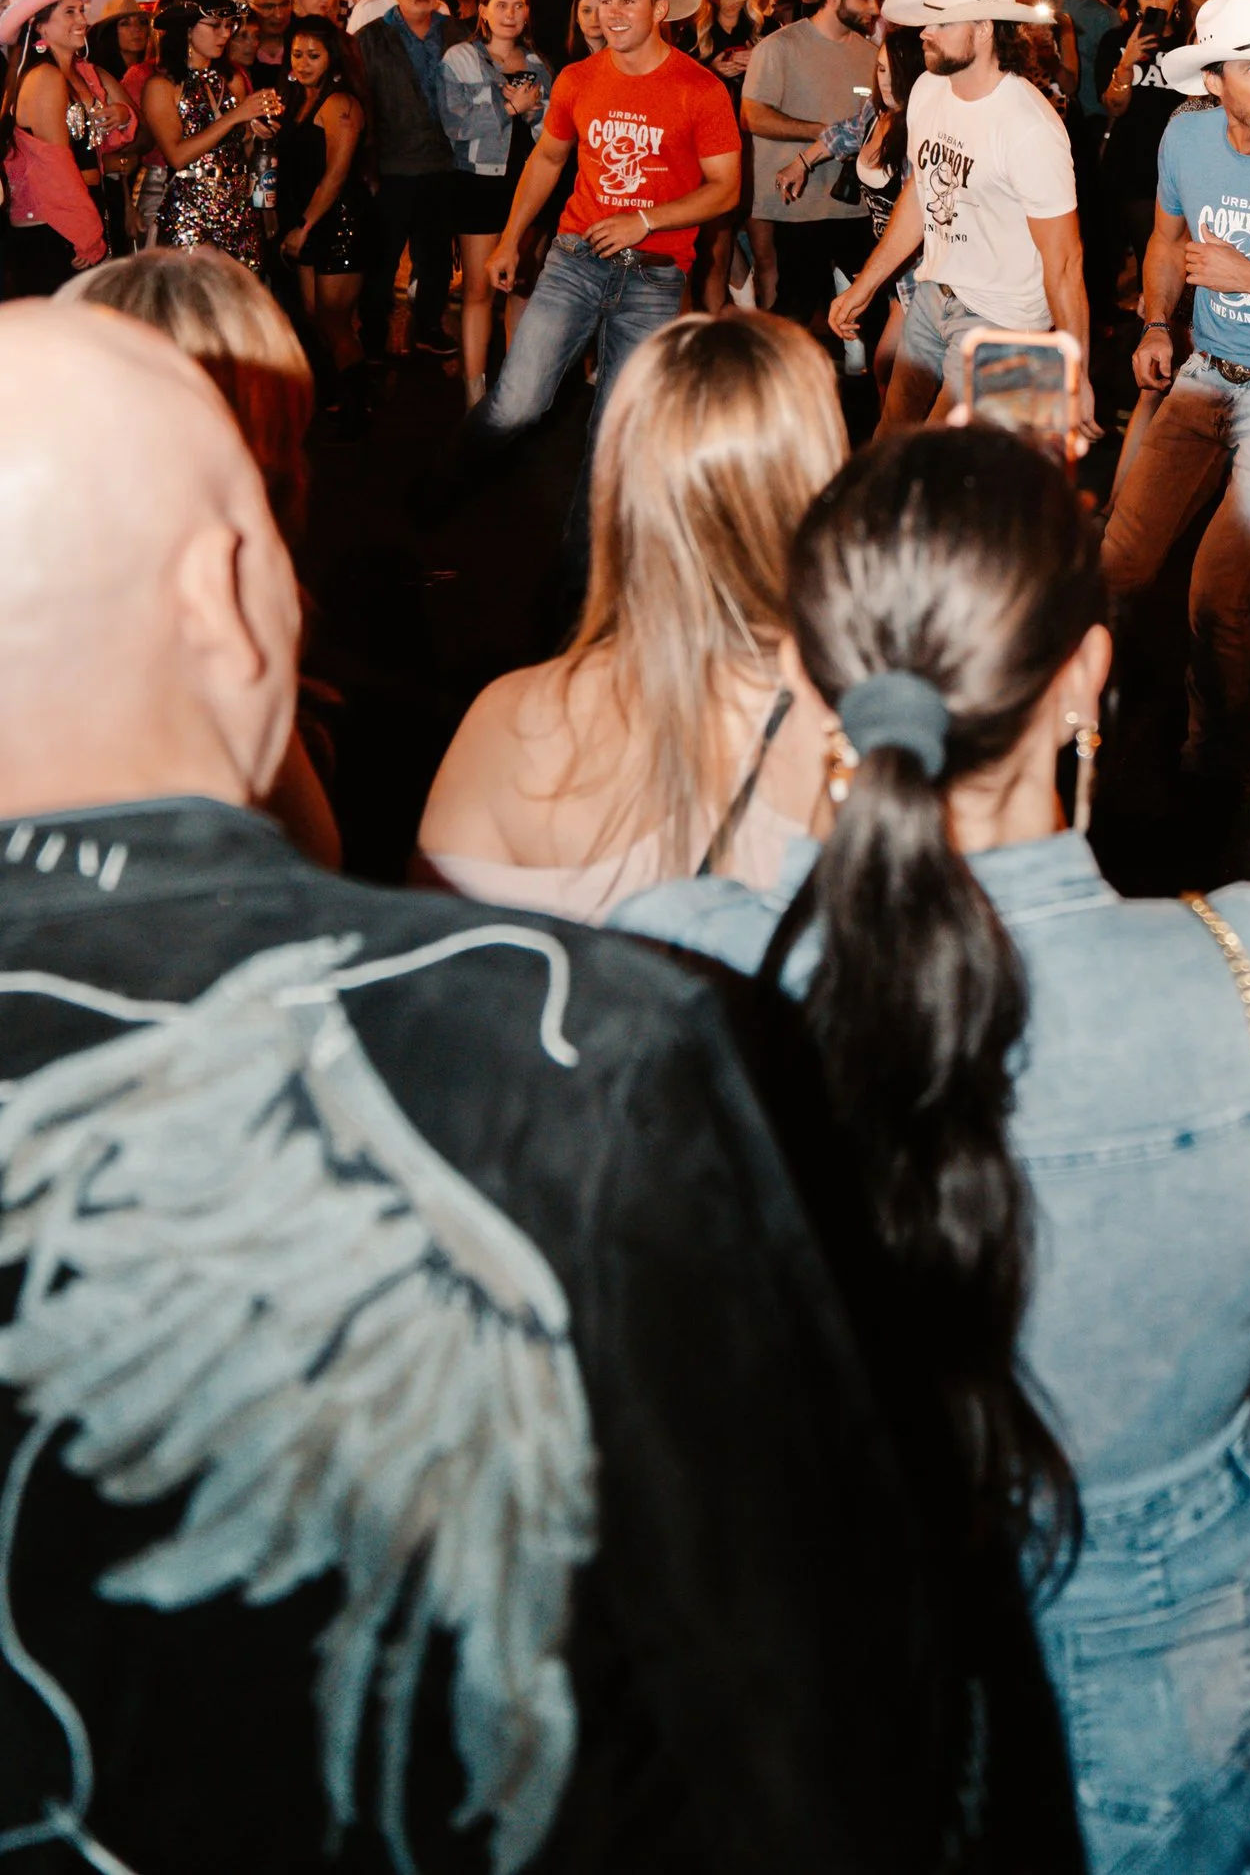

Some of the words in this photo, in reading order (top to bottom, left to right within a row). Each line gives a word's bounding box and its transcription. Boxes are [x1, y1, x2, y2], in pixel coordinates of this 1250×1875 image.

[608, 110, 648, 123] URBAN
[588, 118, 665, 156] COWBOY
[937, 131, 965, 150] URBAN
[917, 138, 975, 189] COWBOY
